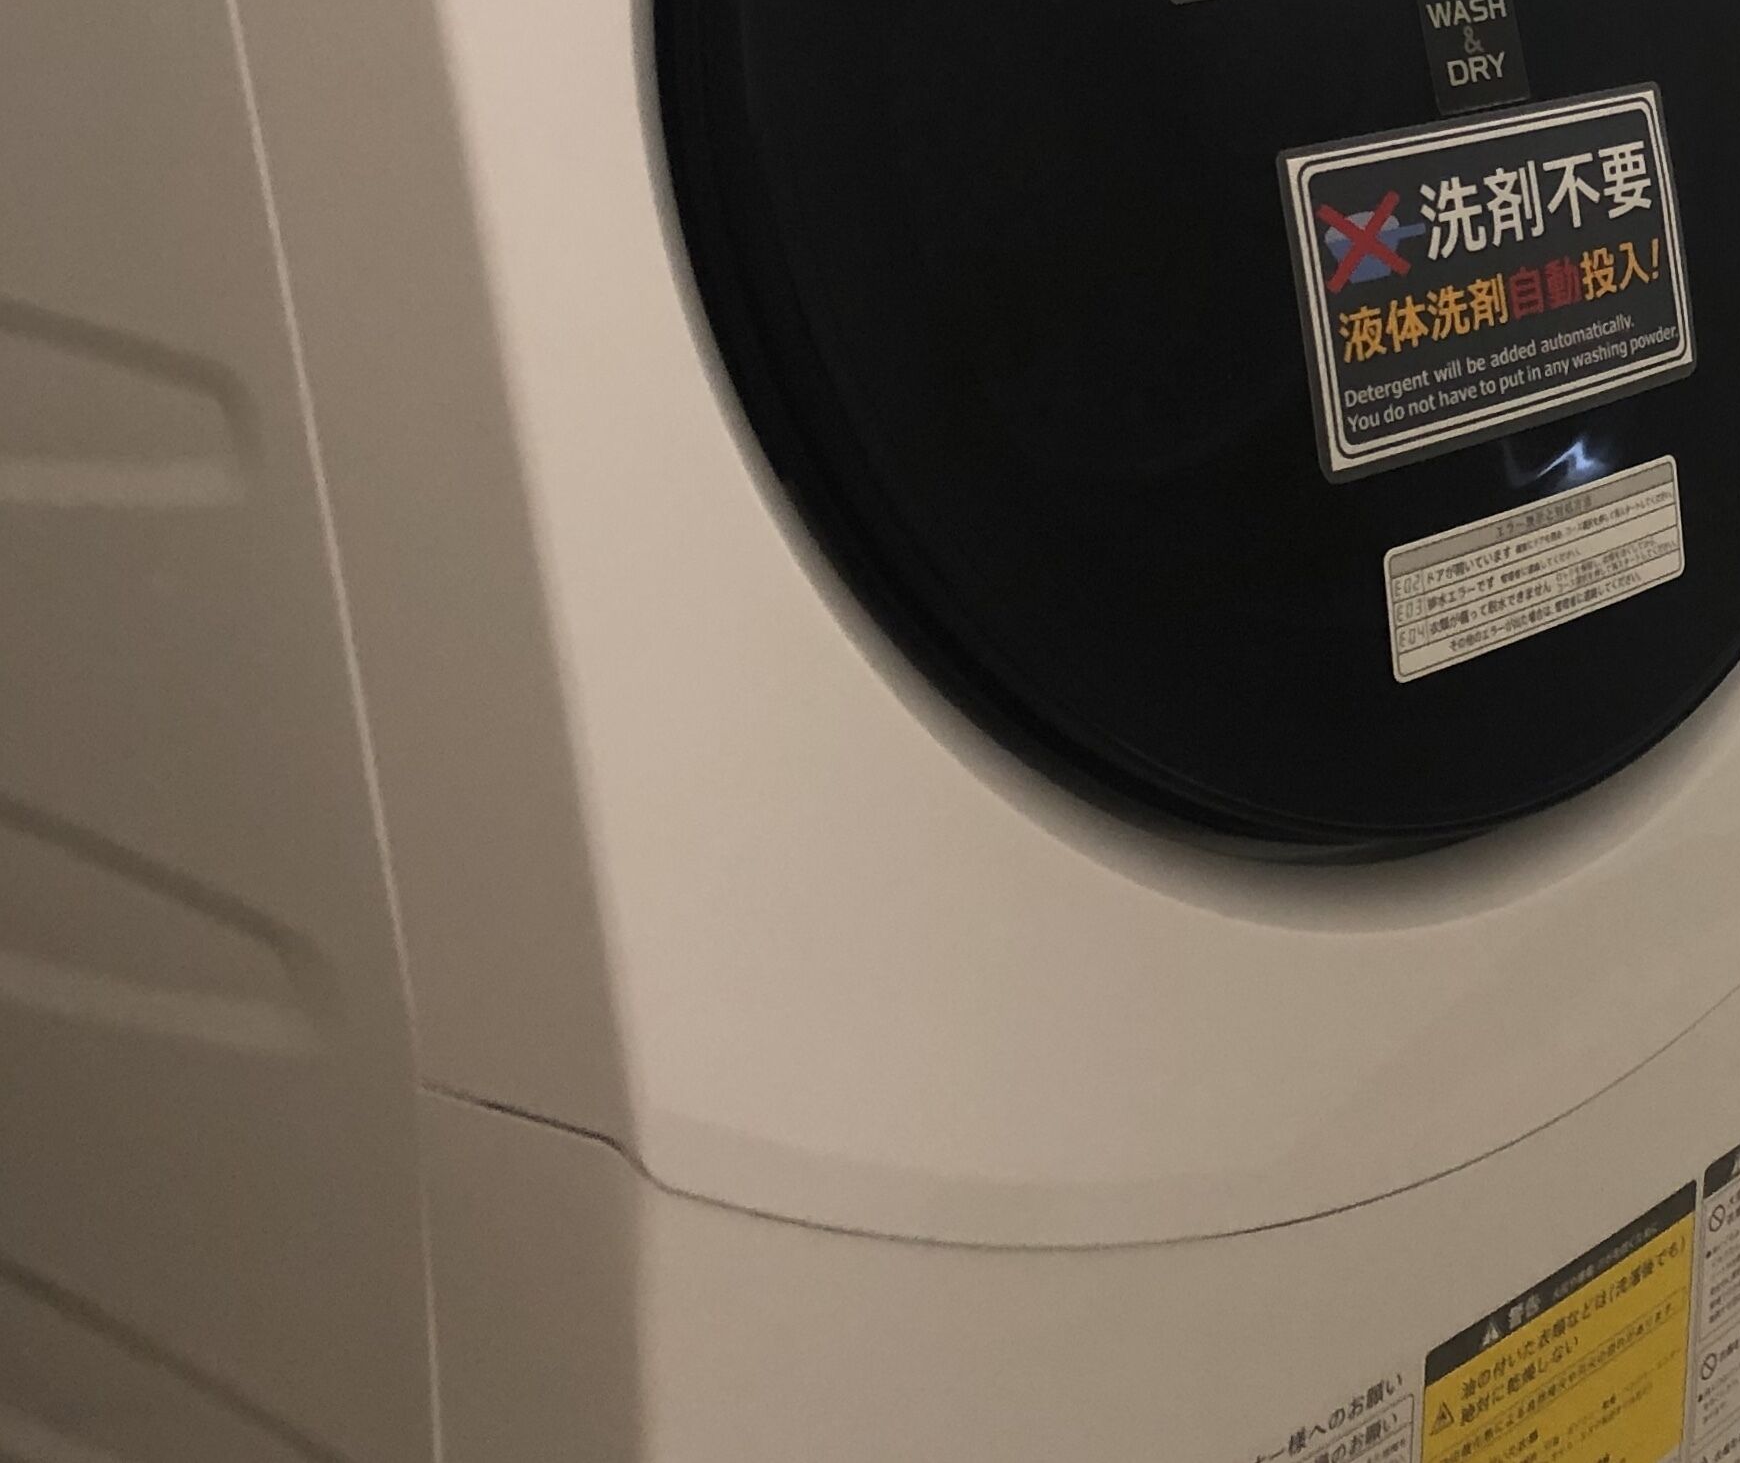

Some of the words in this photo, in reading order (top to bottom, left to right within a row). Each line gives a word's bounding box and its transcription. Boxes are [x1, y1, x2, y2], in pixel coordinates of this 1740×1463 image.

[1446, 50, 1507, 88] DRY
[1463, 26, 1485, 56] &
[1417, 138, 1655, 262] 洗剤不要
[1344, 370, 1431, 409] Detergent
[1434, 356, 1463, 382] will
[1466, 354, 1487, 375] be
[1490, 339, 1538, 367] added
[1540, 312, 1636, 354] automatically.
[1347, 410, 1381, 434] You
[1383, 399, 1406, 424] do
[1408, 395, 1437, 417] not
[1438, 385, 1478, 409] have
[1479, 379, 1497, 398] to
[1499, 370, 1526, 396] put
[1527, 363, 1543, 382] in
[1544, 356, 1571, 379] any
[1572, 338, 1629, 368] washing
[1630, 324, 1679, 355] powder.
